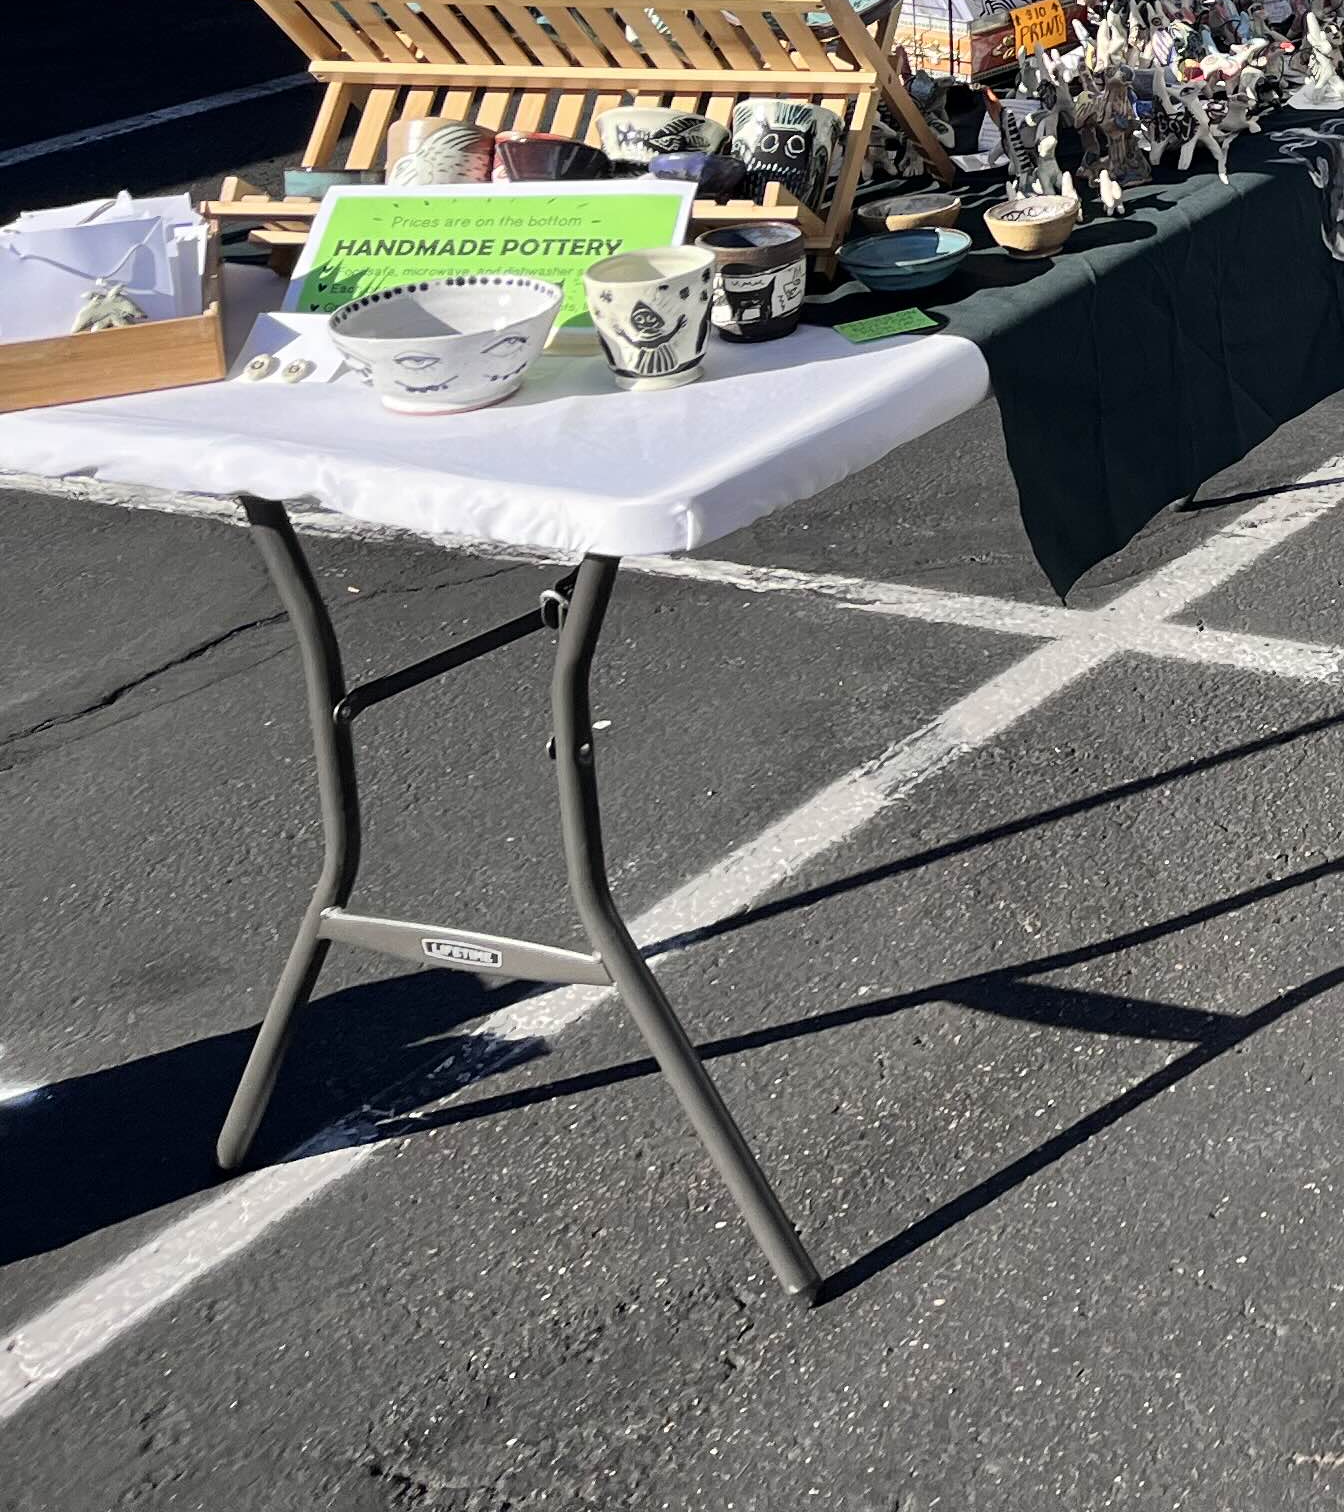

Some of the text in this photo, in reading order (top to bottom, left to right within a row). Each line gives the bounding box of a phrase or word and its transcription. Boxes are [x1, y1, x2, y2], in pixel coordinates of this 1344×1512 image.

[392, 216, 582, 228] Prices are on the bottom
[333, 238, 624, 256] HANDMADE POTTERY
